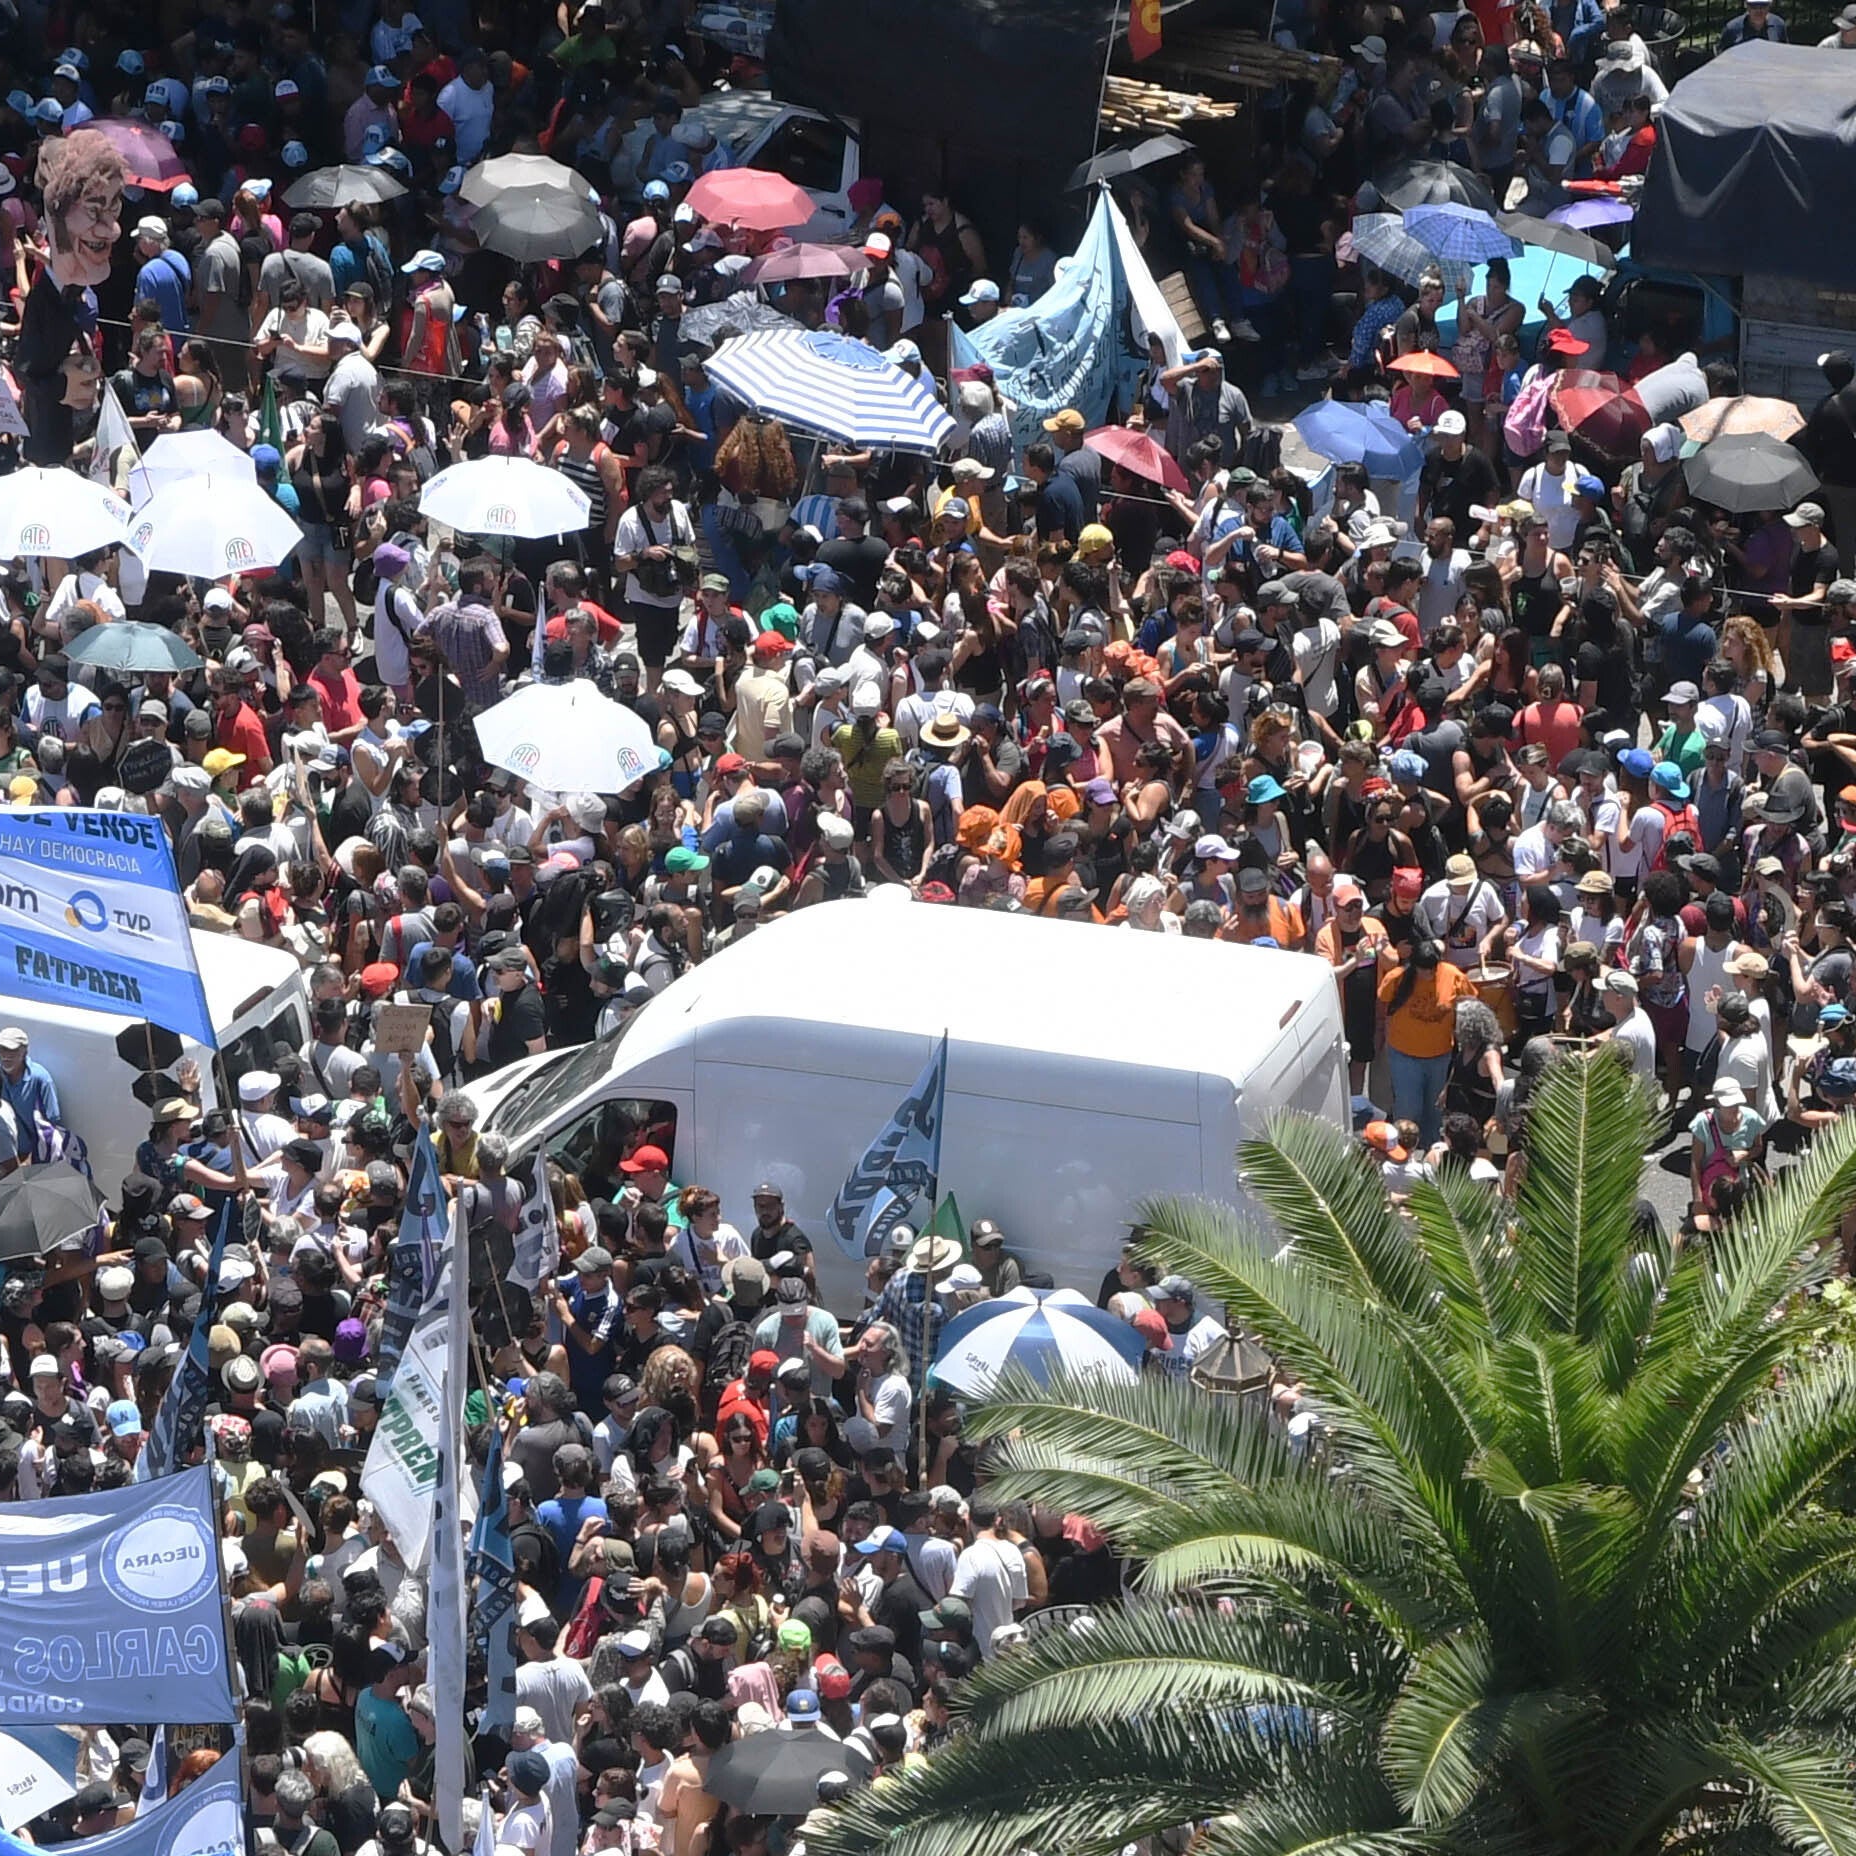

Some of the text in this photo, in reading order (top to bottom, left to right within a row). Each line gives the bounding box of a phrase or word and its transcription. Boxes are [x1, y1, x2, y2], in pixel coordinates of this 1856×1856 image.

[63, 813, 158, 851] VENDE
[0, 834, 39, 857] HAY
[40, 838, 142, 874] DEMOCRACIA
